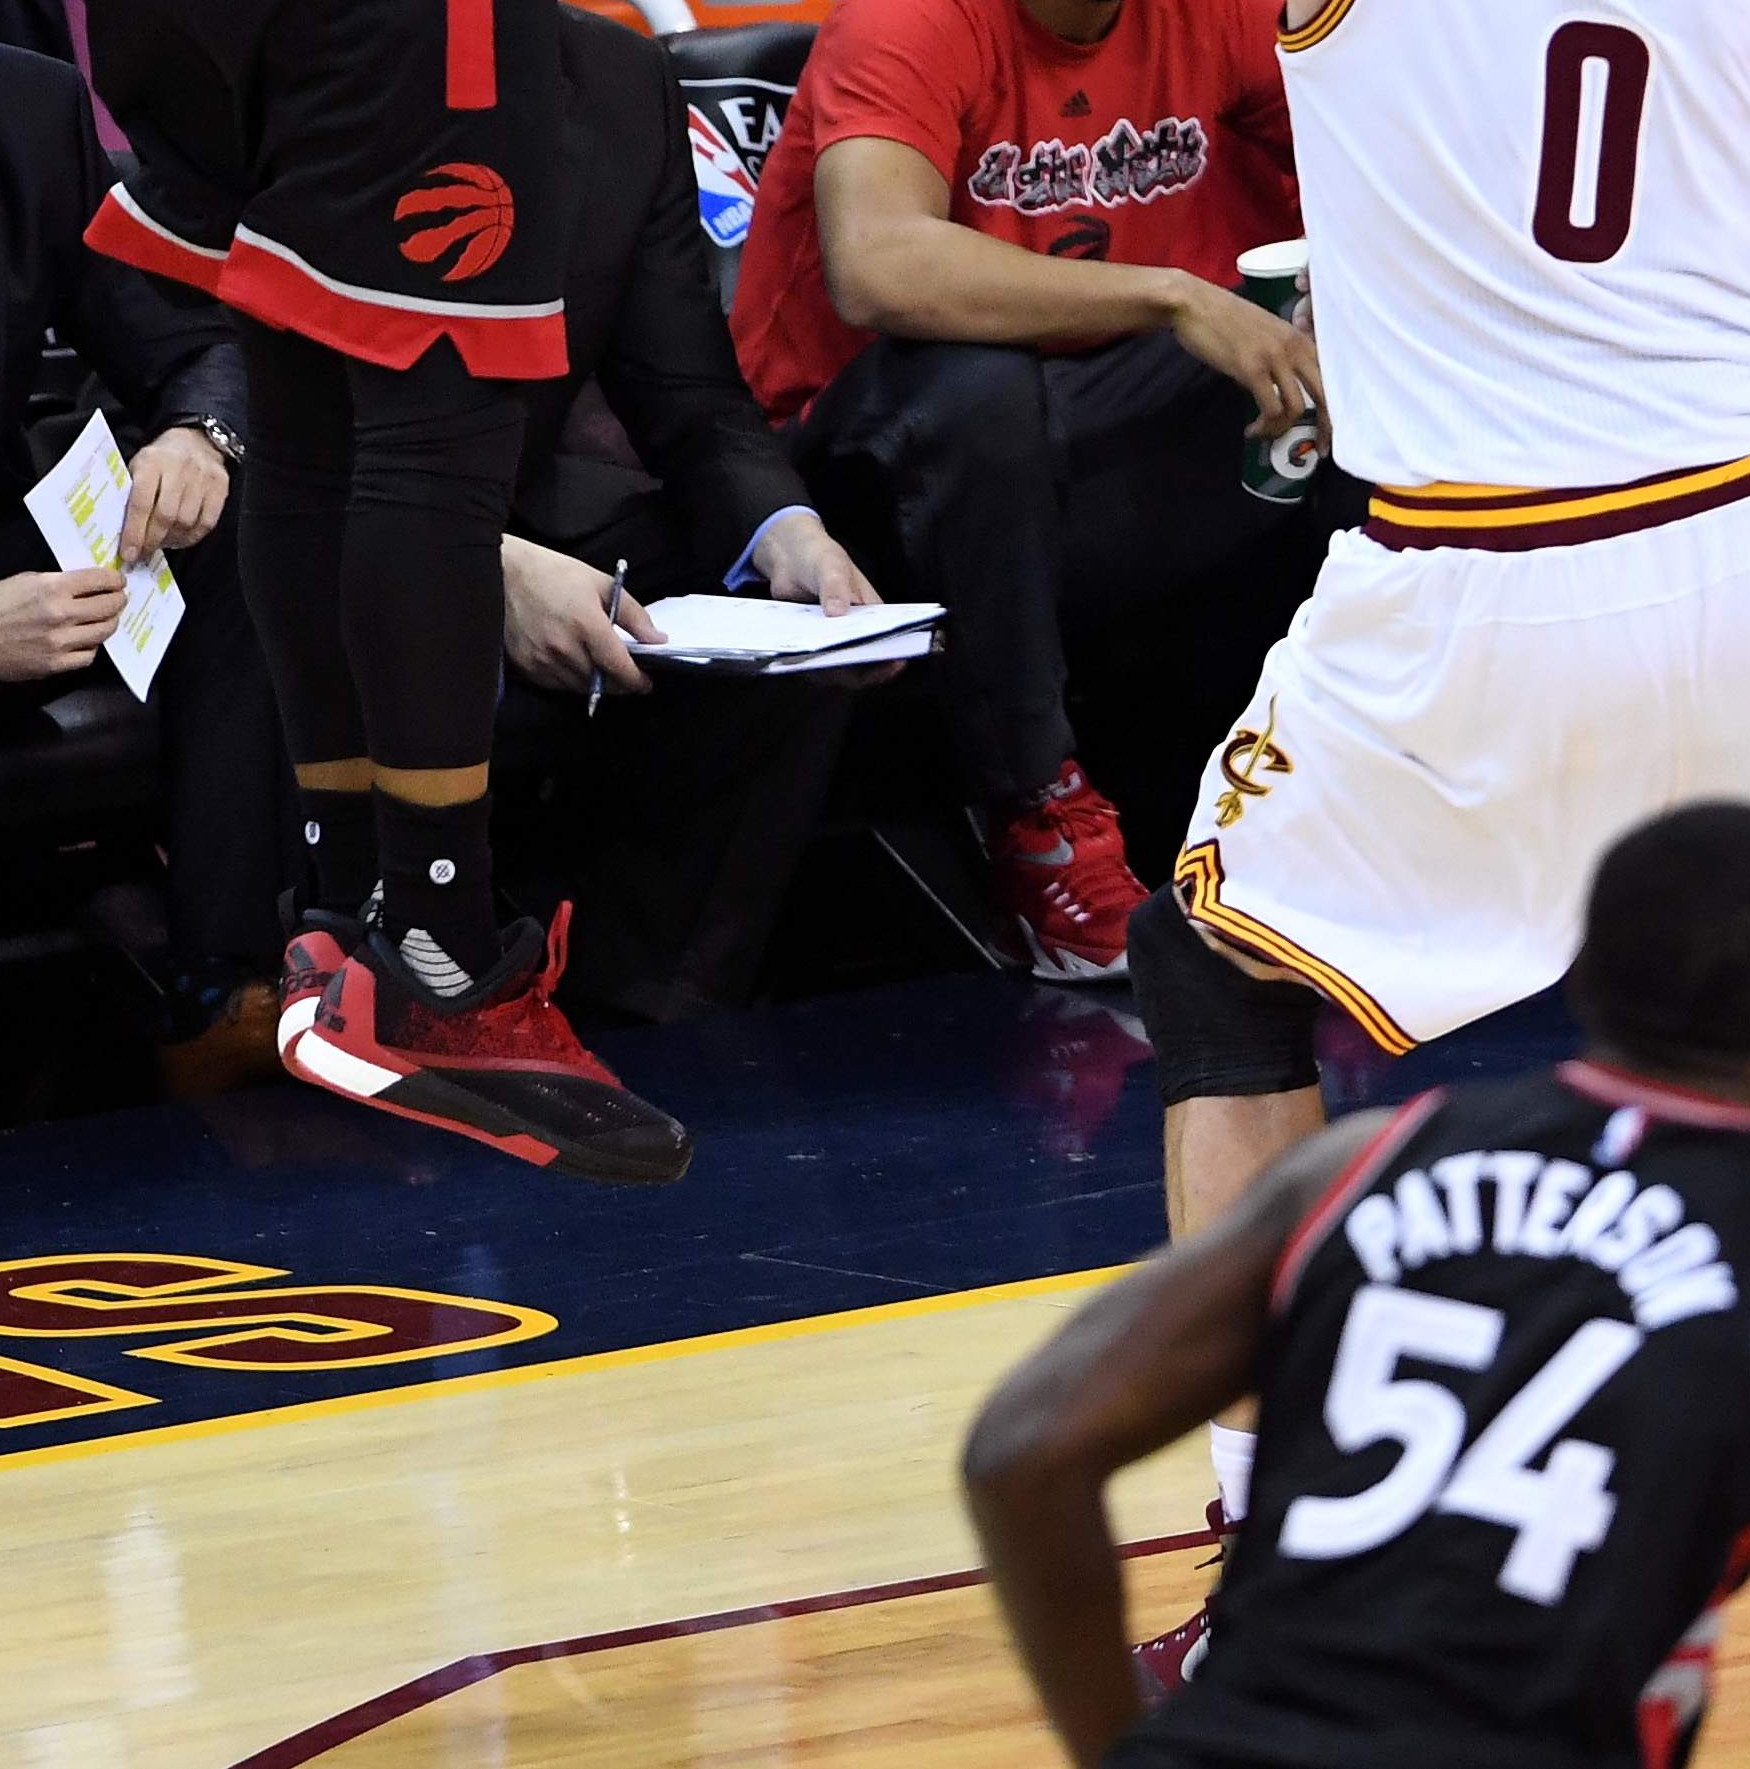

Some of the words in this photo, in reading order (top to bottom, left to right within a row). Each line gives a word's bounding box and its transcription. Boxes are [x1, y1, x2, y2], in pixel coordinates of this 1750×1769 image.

[1531, 19, 1652, 265] 0
[1345, 1148, 1739, 1333] PATTERSON
[1277, 1282, 1648, 1610] 54
